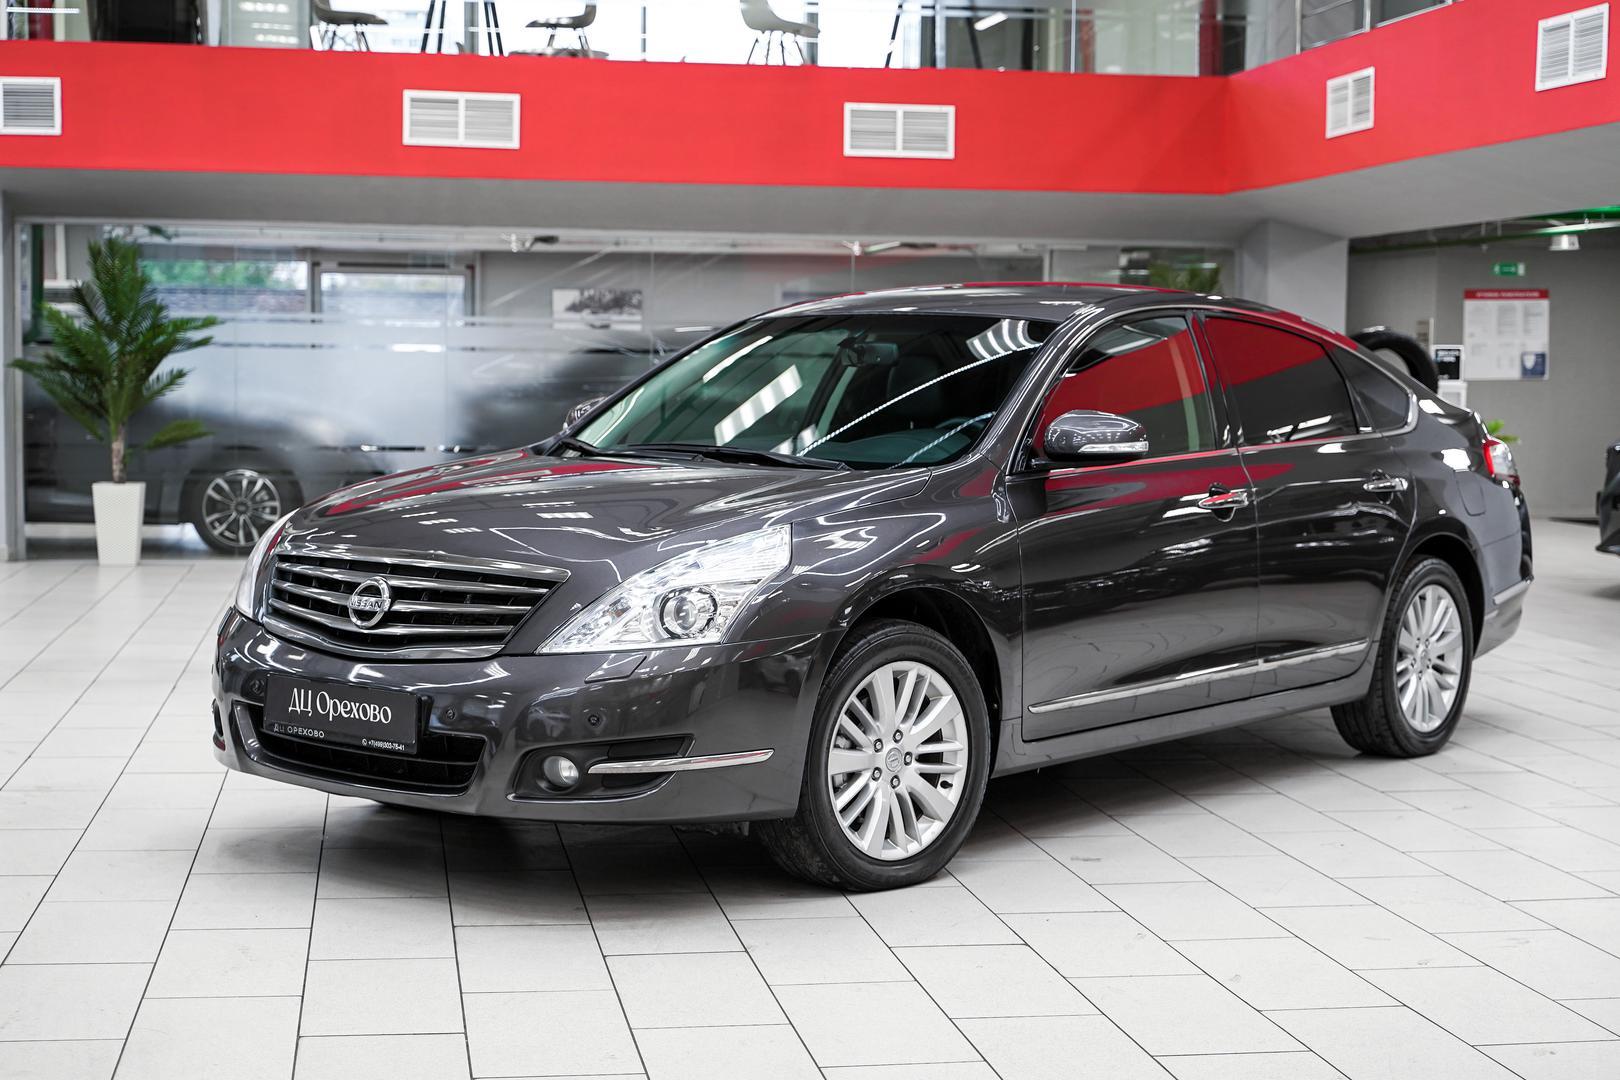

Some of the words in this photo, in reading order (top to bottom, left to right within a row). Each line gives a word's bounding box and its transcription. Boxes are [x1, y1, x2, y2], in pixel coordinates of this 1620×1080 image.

[289, 687, 312, 717] ДЦ
[316, 691, 392, 724] Орехово
[273, 723, 285, 733] ДЦ
[287, 725, 325, 738] ОРЕХОВО
